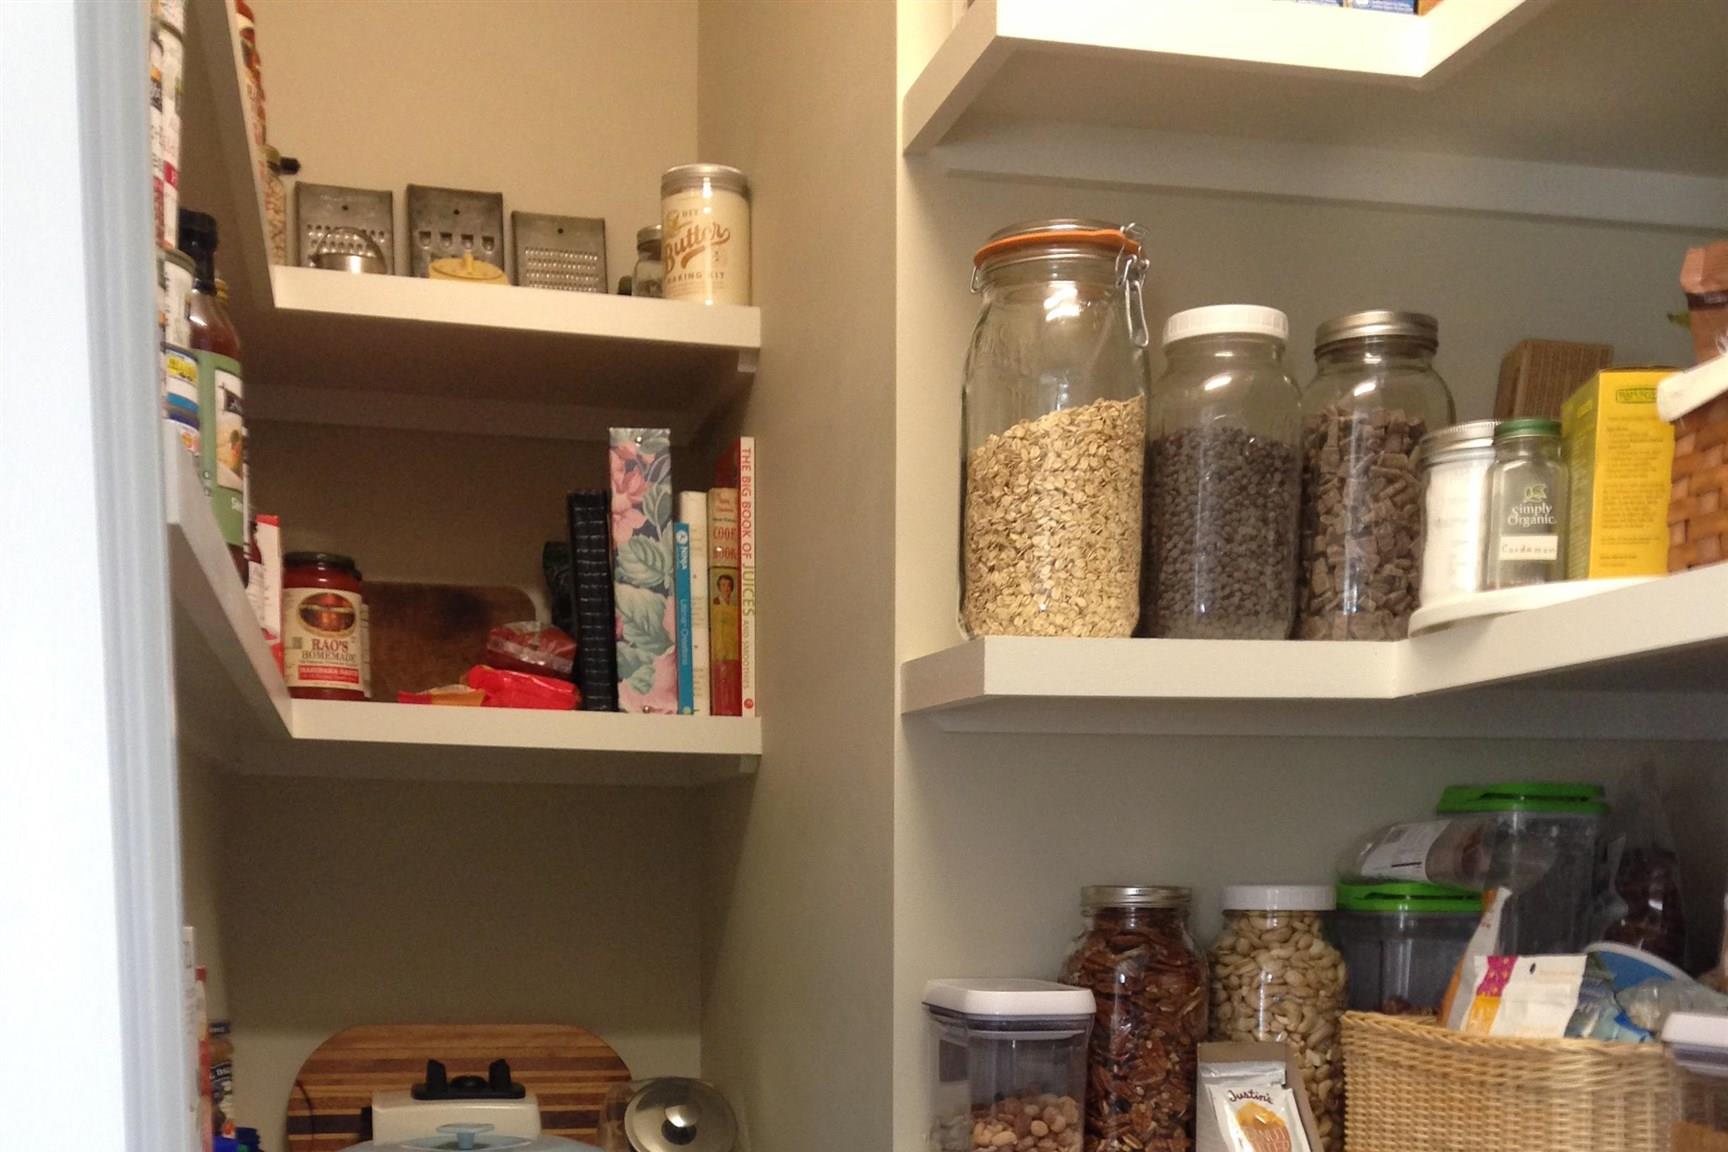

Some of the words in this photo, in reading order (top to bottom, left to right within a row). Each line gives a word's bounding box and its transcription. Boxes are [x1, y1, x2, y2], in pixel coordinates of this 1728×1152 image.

[664, 221, 731, 274] Butter
[742, 448, 752, 471] THE
[742, 475, 752, 497] BIG
[742, 501, 752, 538] BOOK
[742, 542, 752, 560] OF
[743, 562, 755, 617] JUICES
[311, 638, 349, 653] RAO'S
[302, 651, 356, 663] HOMEMADE
